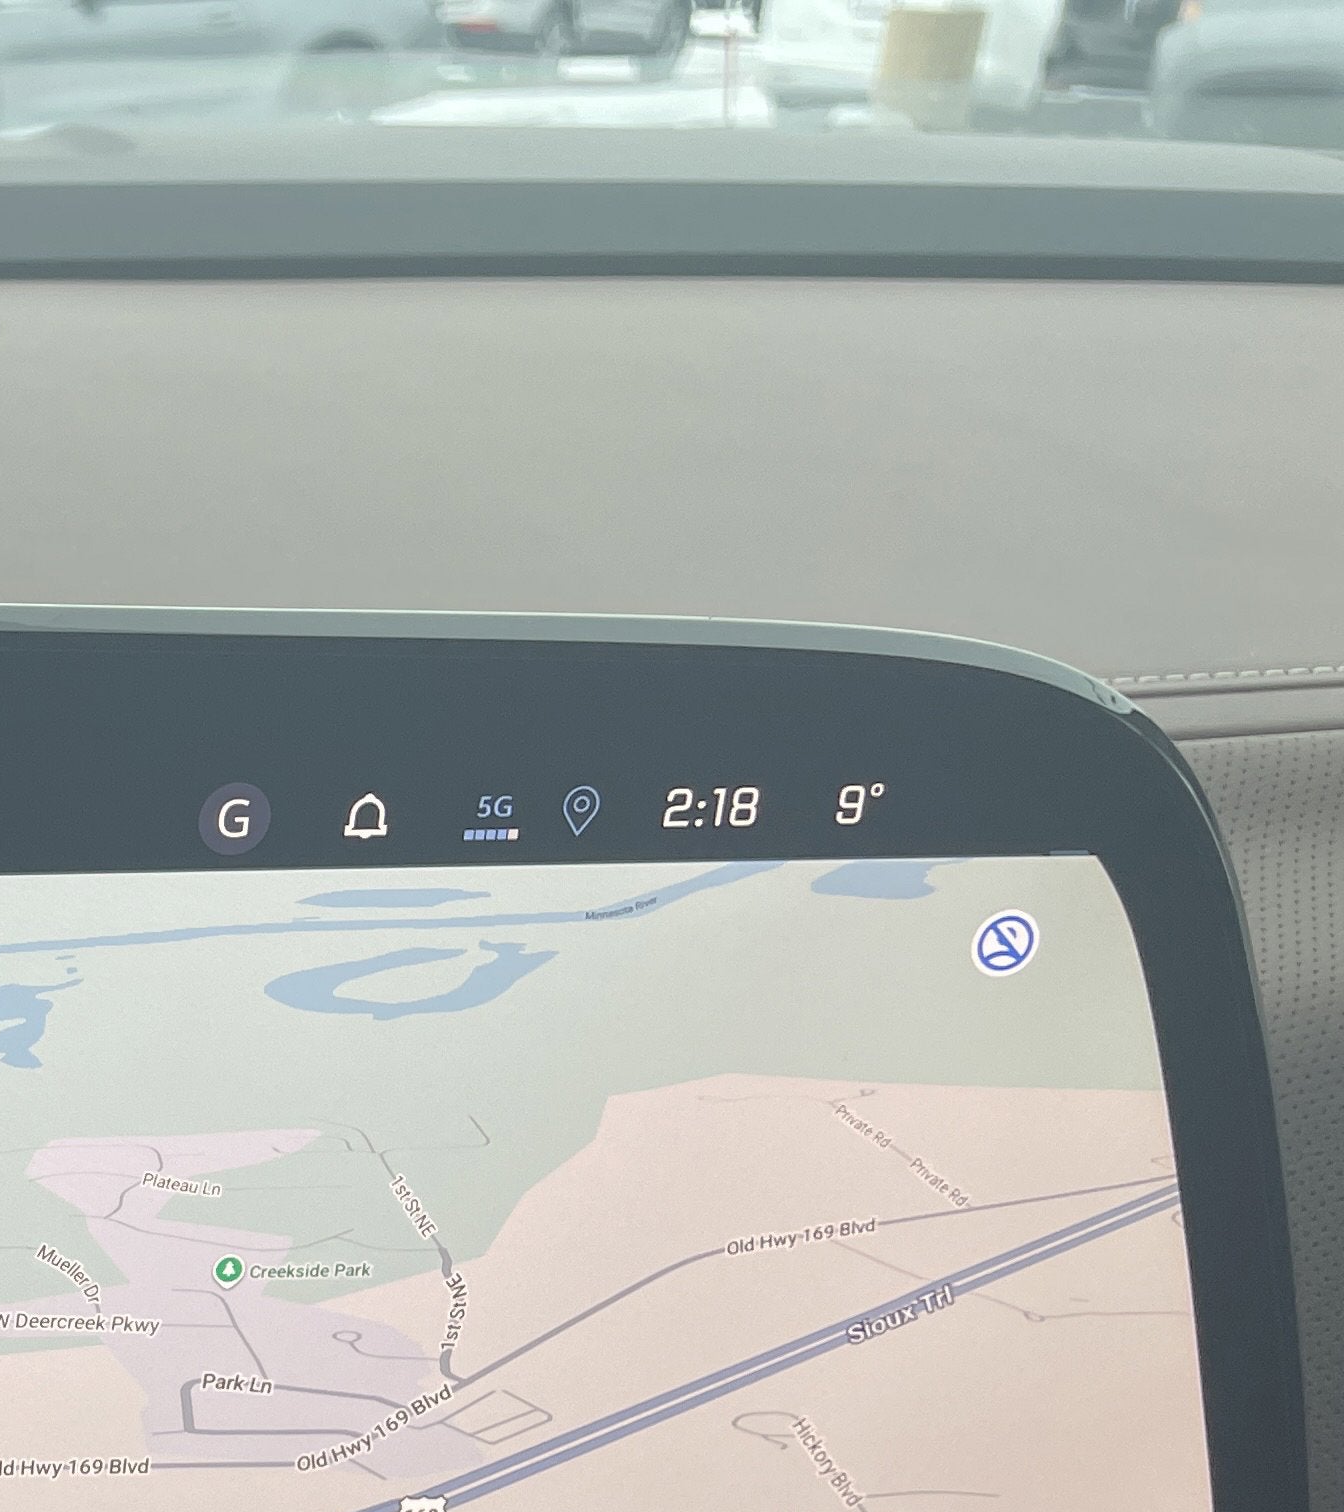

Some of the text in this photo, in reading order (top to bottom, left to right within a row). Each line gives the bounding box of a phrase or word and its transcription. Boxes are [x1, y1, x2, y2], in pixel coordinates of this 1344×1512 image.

[218, 799, 250, 838] G
[477, 796, 512, 818] 5G
[663, 787, 759, 827] 2:18
[837, 782, 885, 824] 9°
[835, 1104, 892, 1149] Private Rd
[142, 1173, 221, 1196] Plateau Ln
[390, 1175, 437, 1238] 1st St NE
[727, 1218, 876, 1256] Old Hwy 169 Blvd
[36, 1244, 100, 1303] Mueller Dr
[249, 1263, 371, 1279] Creekside Park
[16, 1313, 106, 1331] Deercreek
[111, 1315, 160, 1336] Pkwy
[846, 1283, 955, 1346] Sioux Trl
[202, 1373, 272, 1394] Park Ln
[296, 1385, 452, 1473] Old Hwy 169 Blvd
[21, 1460, 62, 1478] Hwy
[69, 1458, 103, 1475] 169
[109, 1457, 150, 1474] Blvd
[793, 1417, 862, 1507] Hickory Blvd
